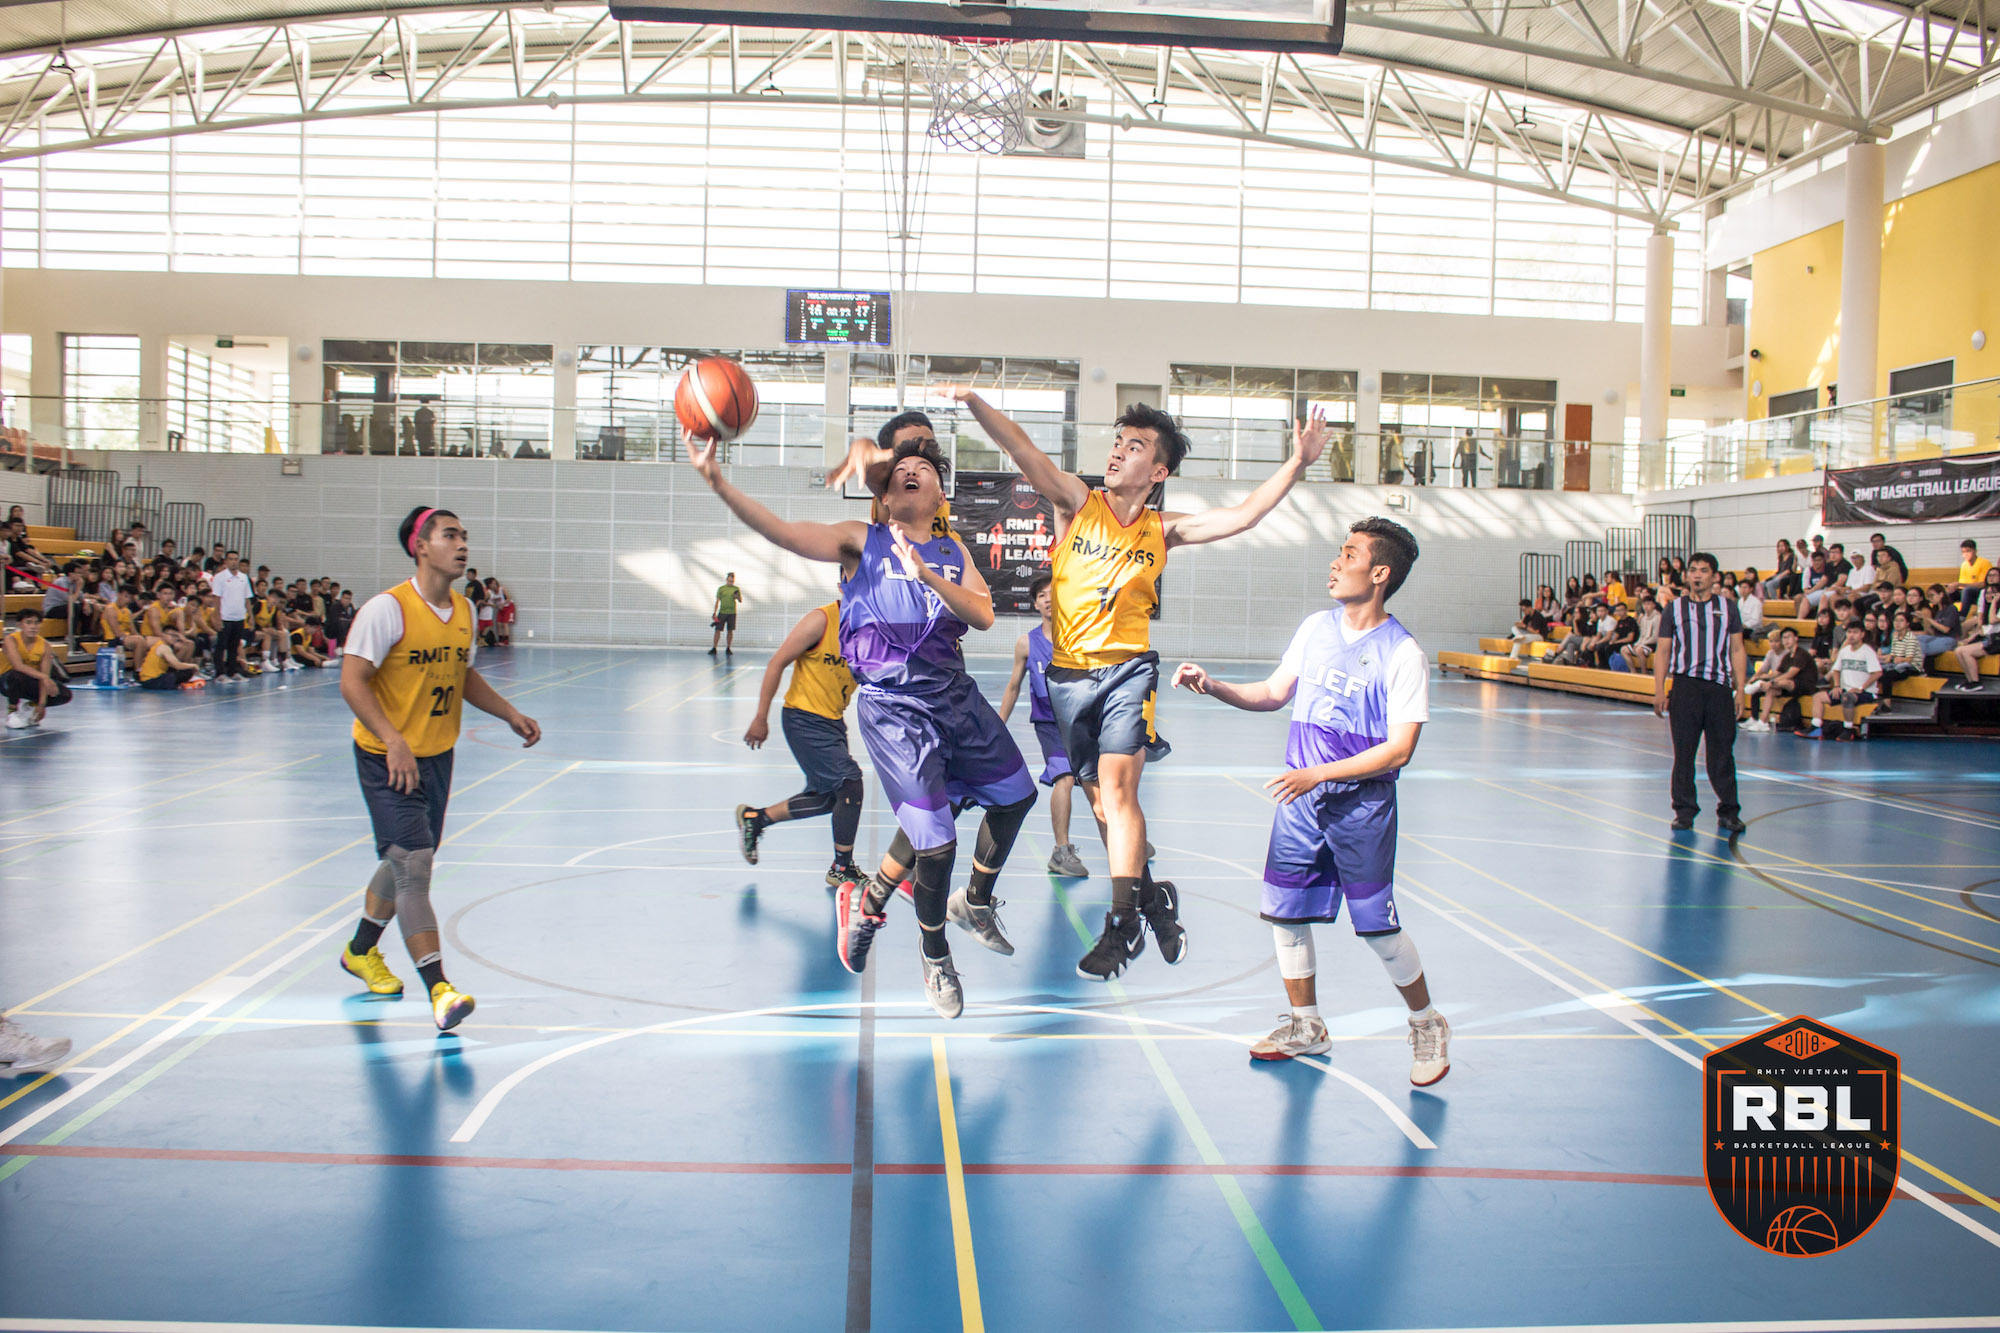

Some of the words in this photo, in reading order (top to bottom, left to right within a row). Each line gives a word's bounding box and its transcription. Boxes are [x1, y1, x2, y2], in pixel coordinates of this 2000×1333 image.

[1015, 484, 1036, 493] RBL
[1854, 486, 1880, 501] RMIT
[1880, 480, 1952, 499] BASKETBALL
[1006, 518, 1044, 531] RMIT
[976, 532, 1054, 546] BASKETBA
[1072, 535, 1121, 561] RMIT
[1126, 549, 1155, 567] SGS
[882, 557, 961, 584] UF
[1015, 564, 1033, 578] 2018
[409, 646, 451, 664] RMIT
[1303, 660, 1369, 698] UEF
[1317, 695, 1336, 722] 2
